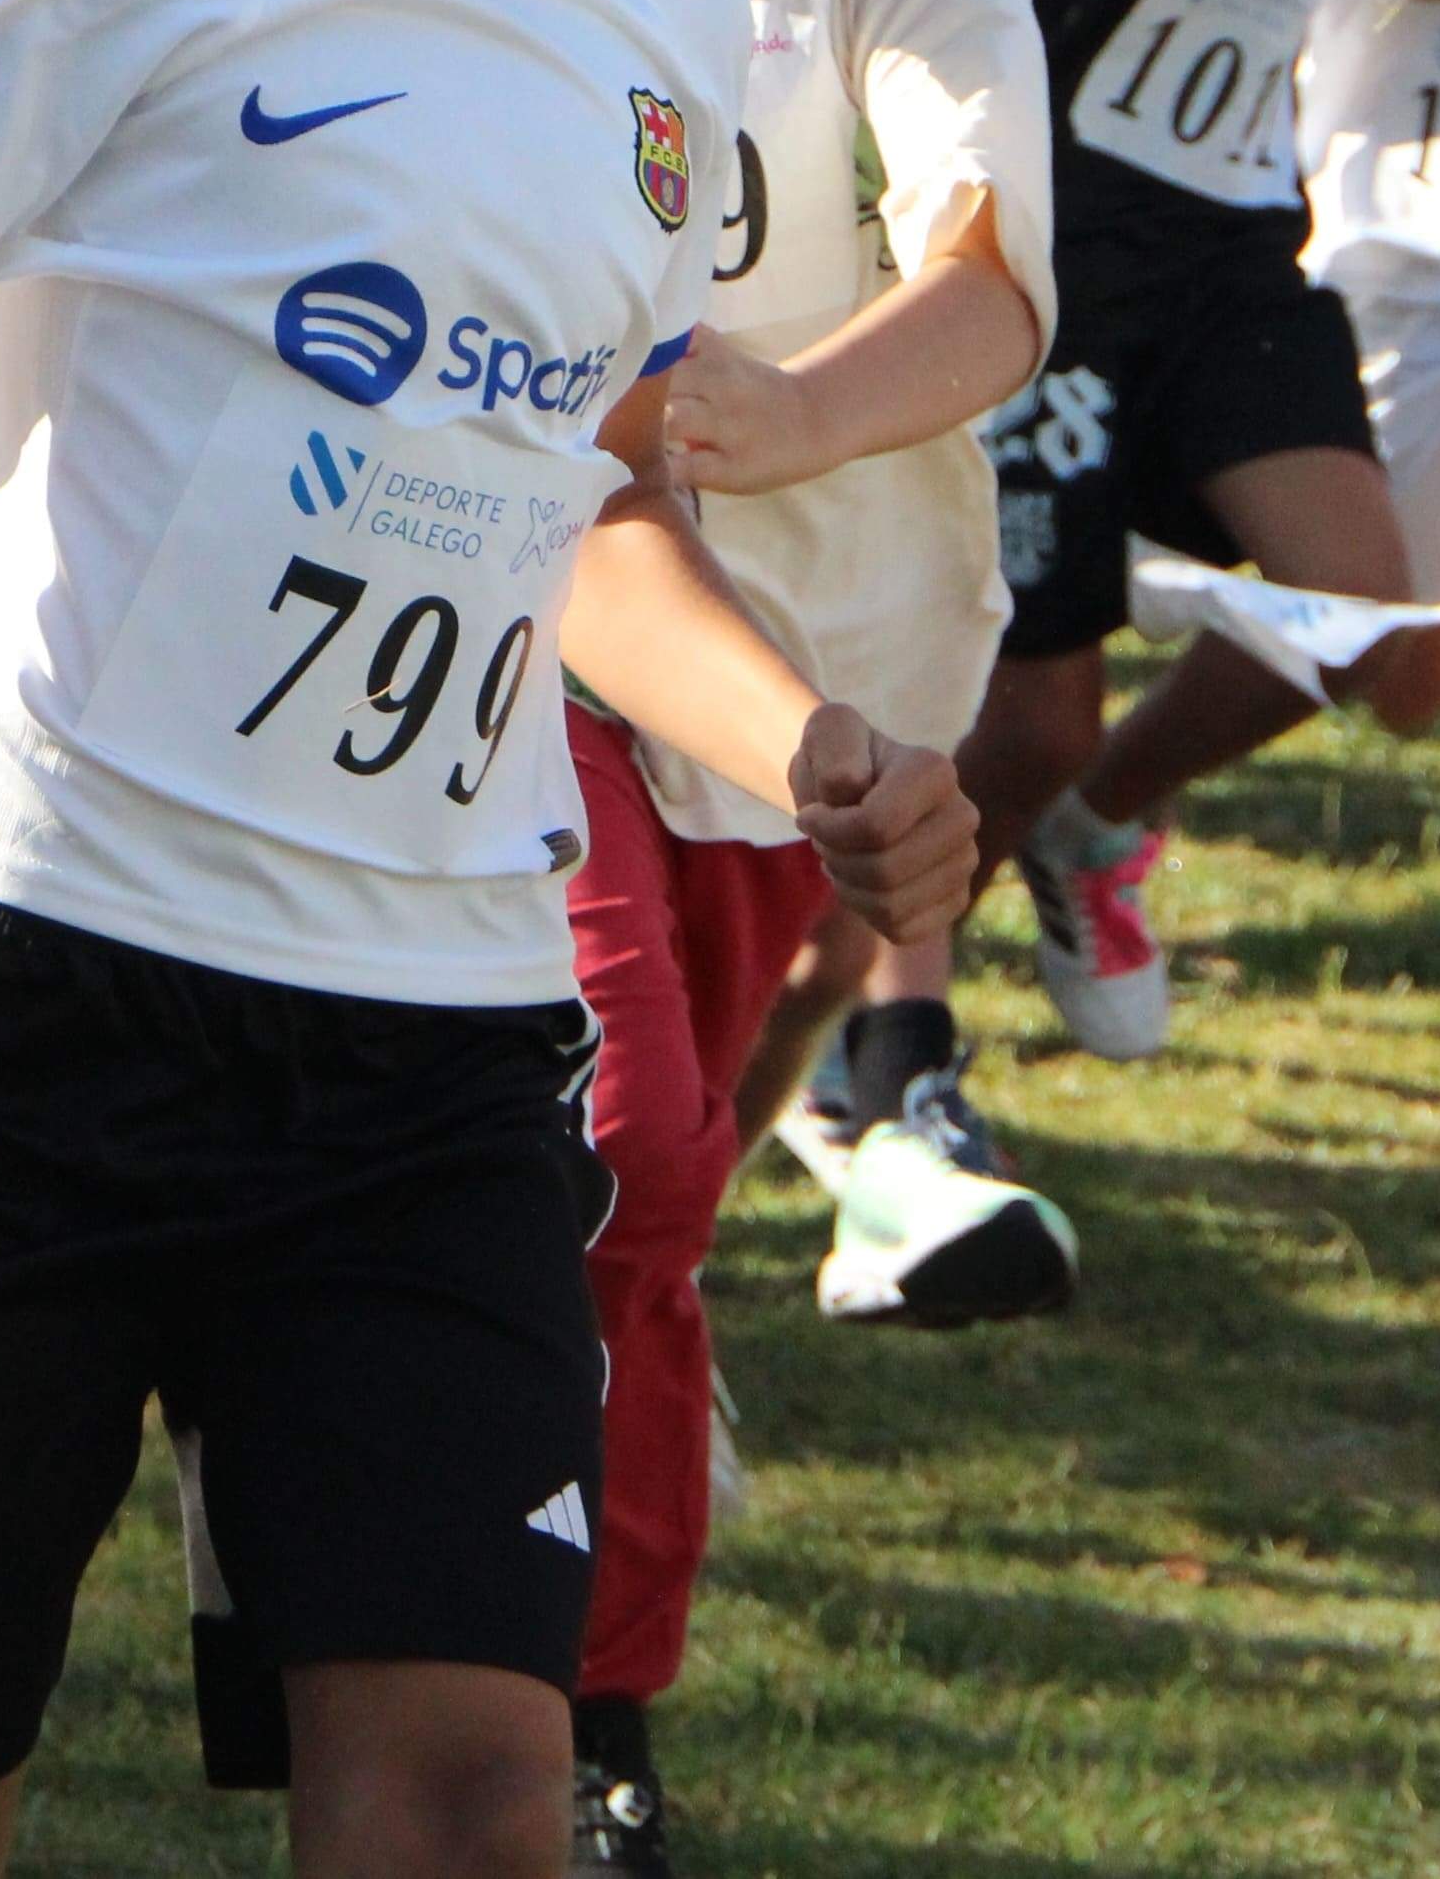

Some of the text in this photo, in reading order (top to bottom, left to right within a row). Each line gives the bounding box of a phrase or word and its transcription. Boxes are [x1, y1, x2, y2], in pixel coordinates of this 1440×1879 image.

[385, 472, 507, 524] DEPORTE
[371, 510, 483, 559] GALEGO
[235, 554, 535, 806] 799
